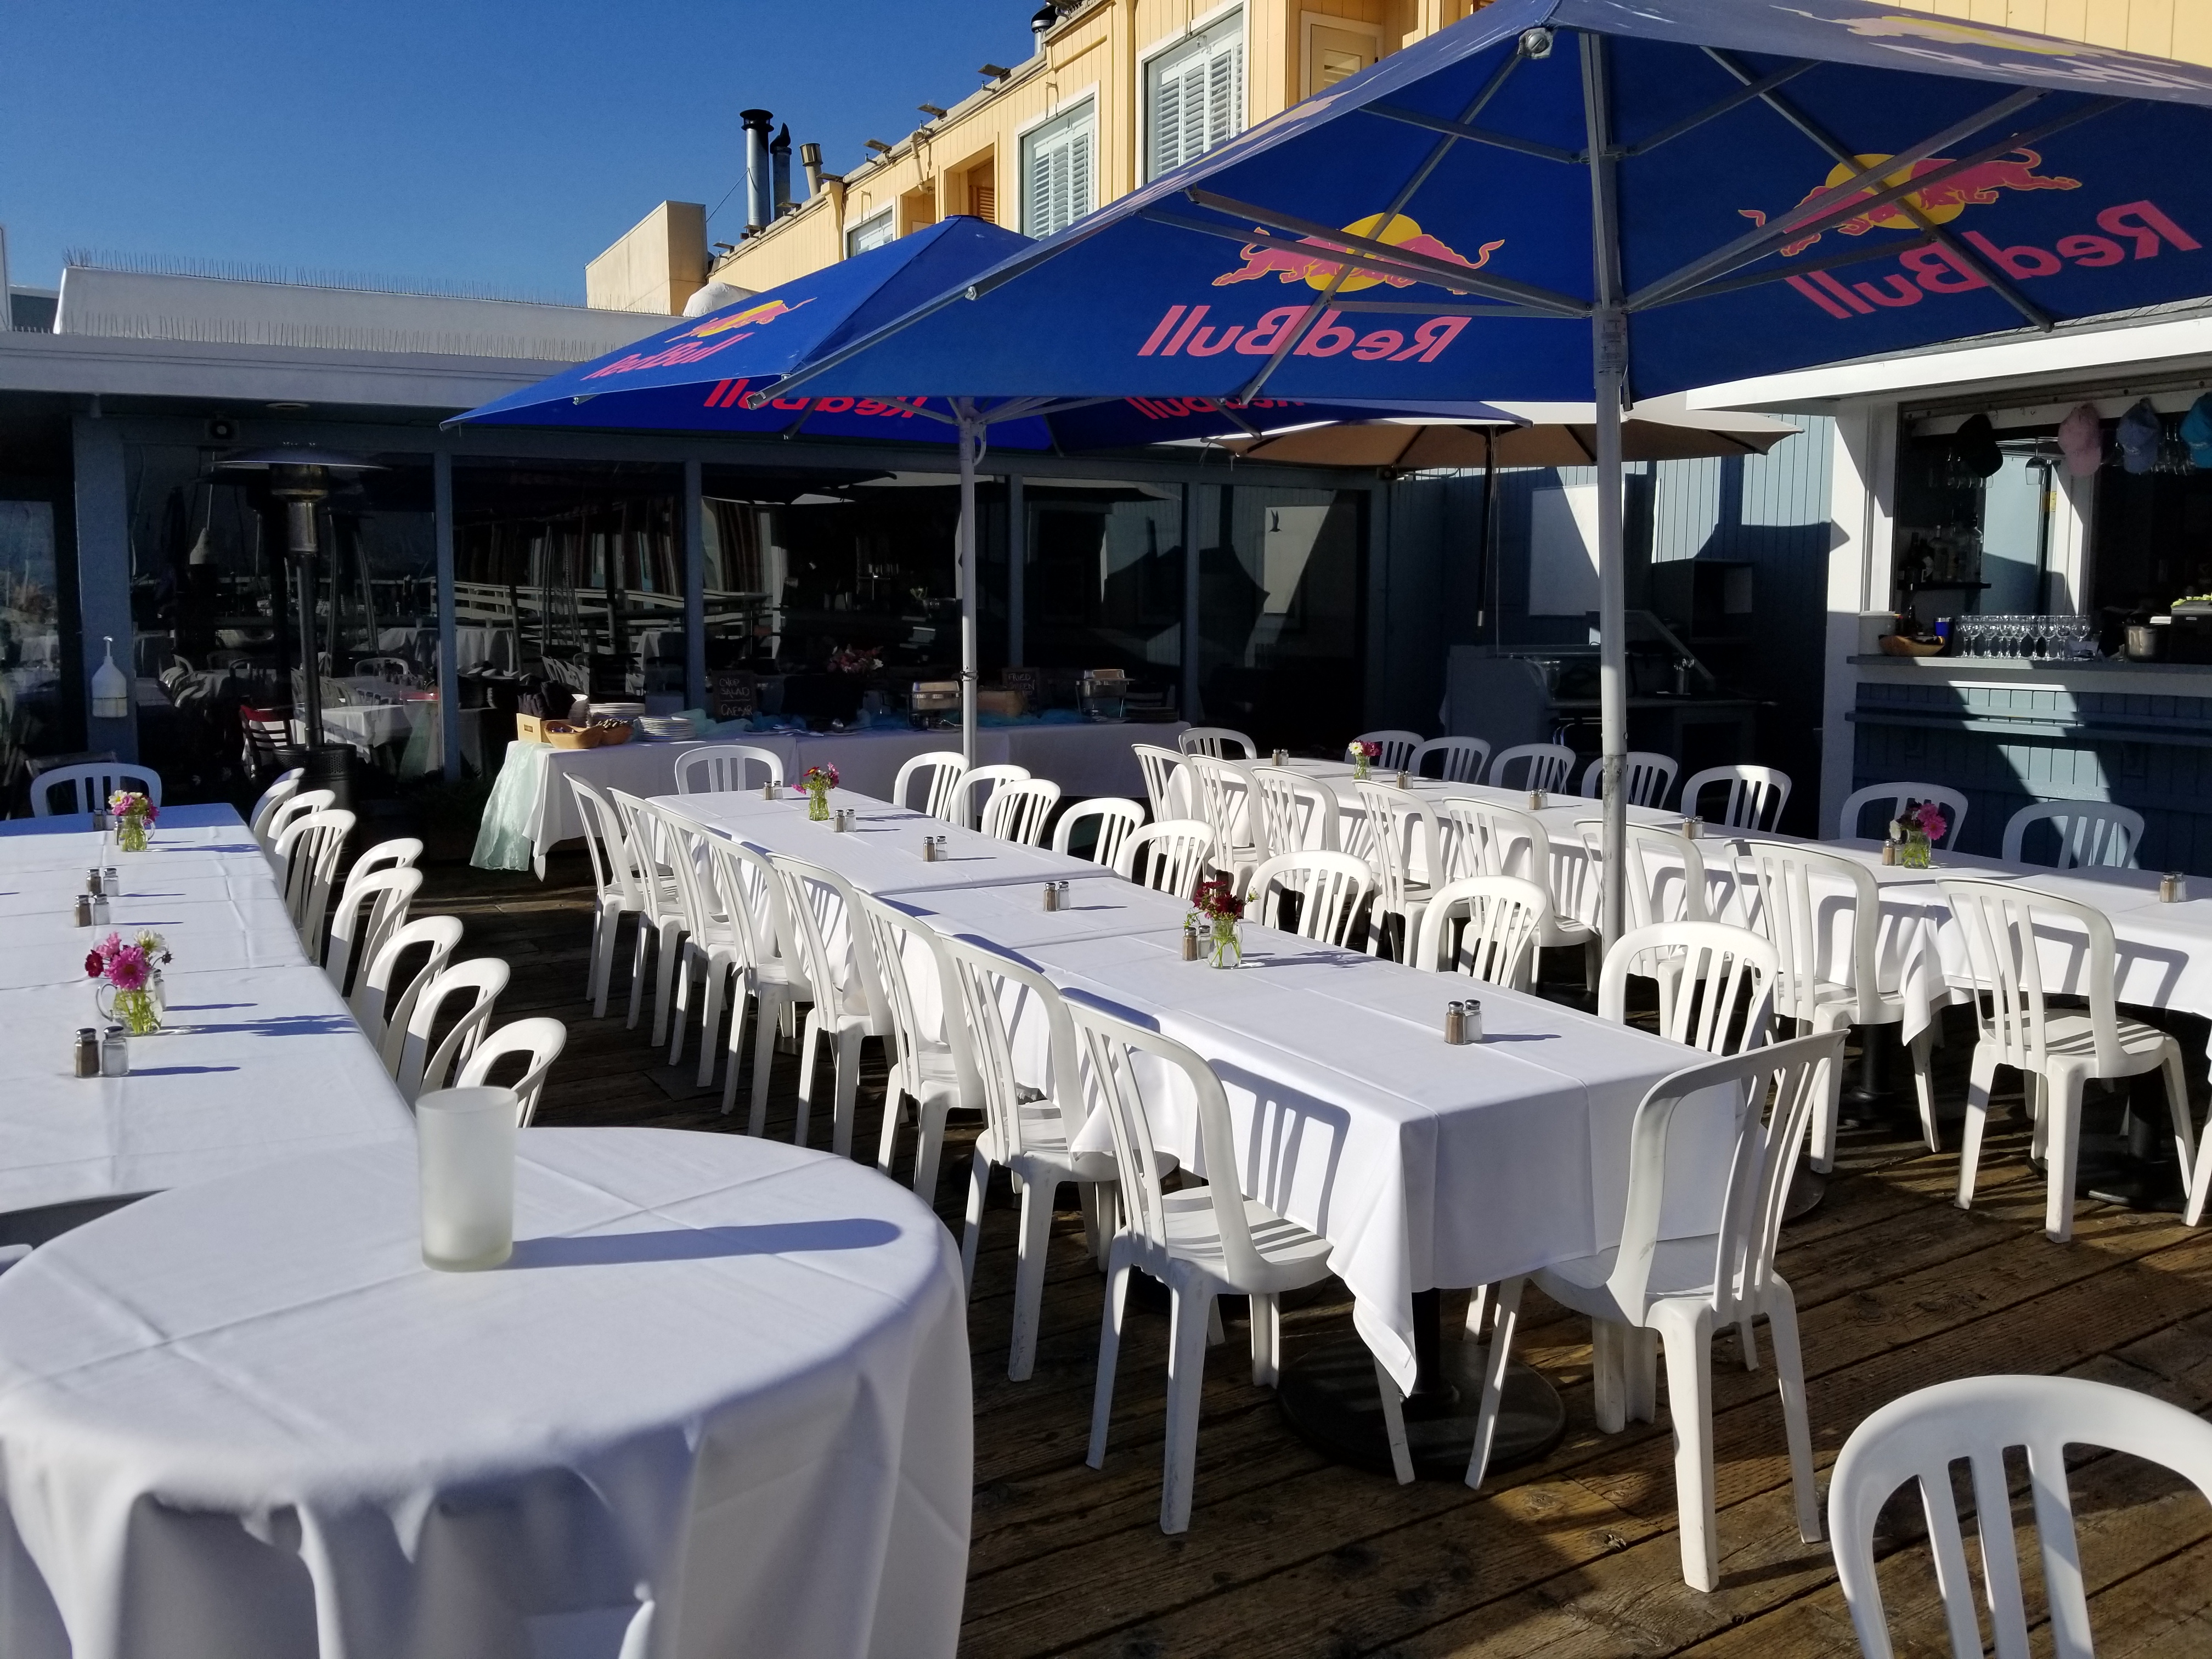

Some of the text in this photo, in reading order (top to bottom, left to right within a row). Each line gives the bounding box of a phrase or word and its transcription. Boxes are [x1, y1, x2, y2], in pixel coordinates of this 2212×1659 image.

[1008, 673, 1031, 681] FRIED
[720, 687, 750, 698] SALAD
[721, 704, 753, 716] CAESAR
